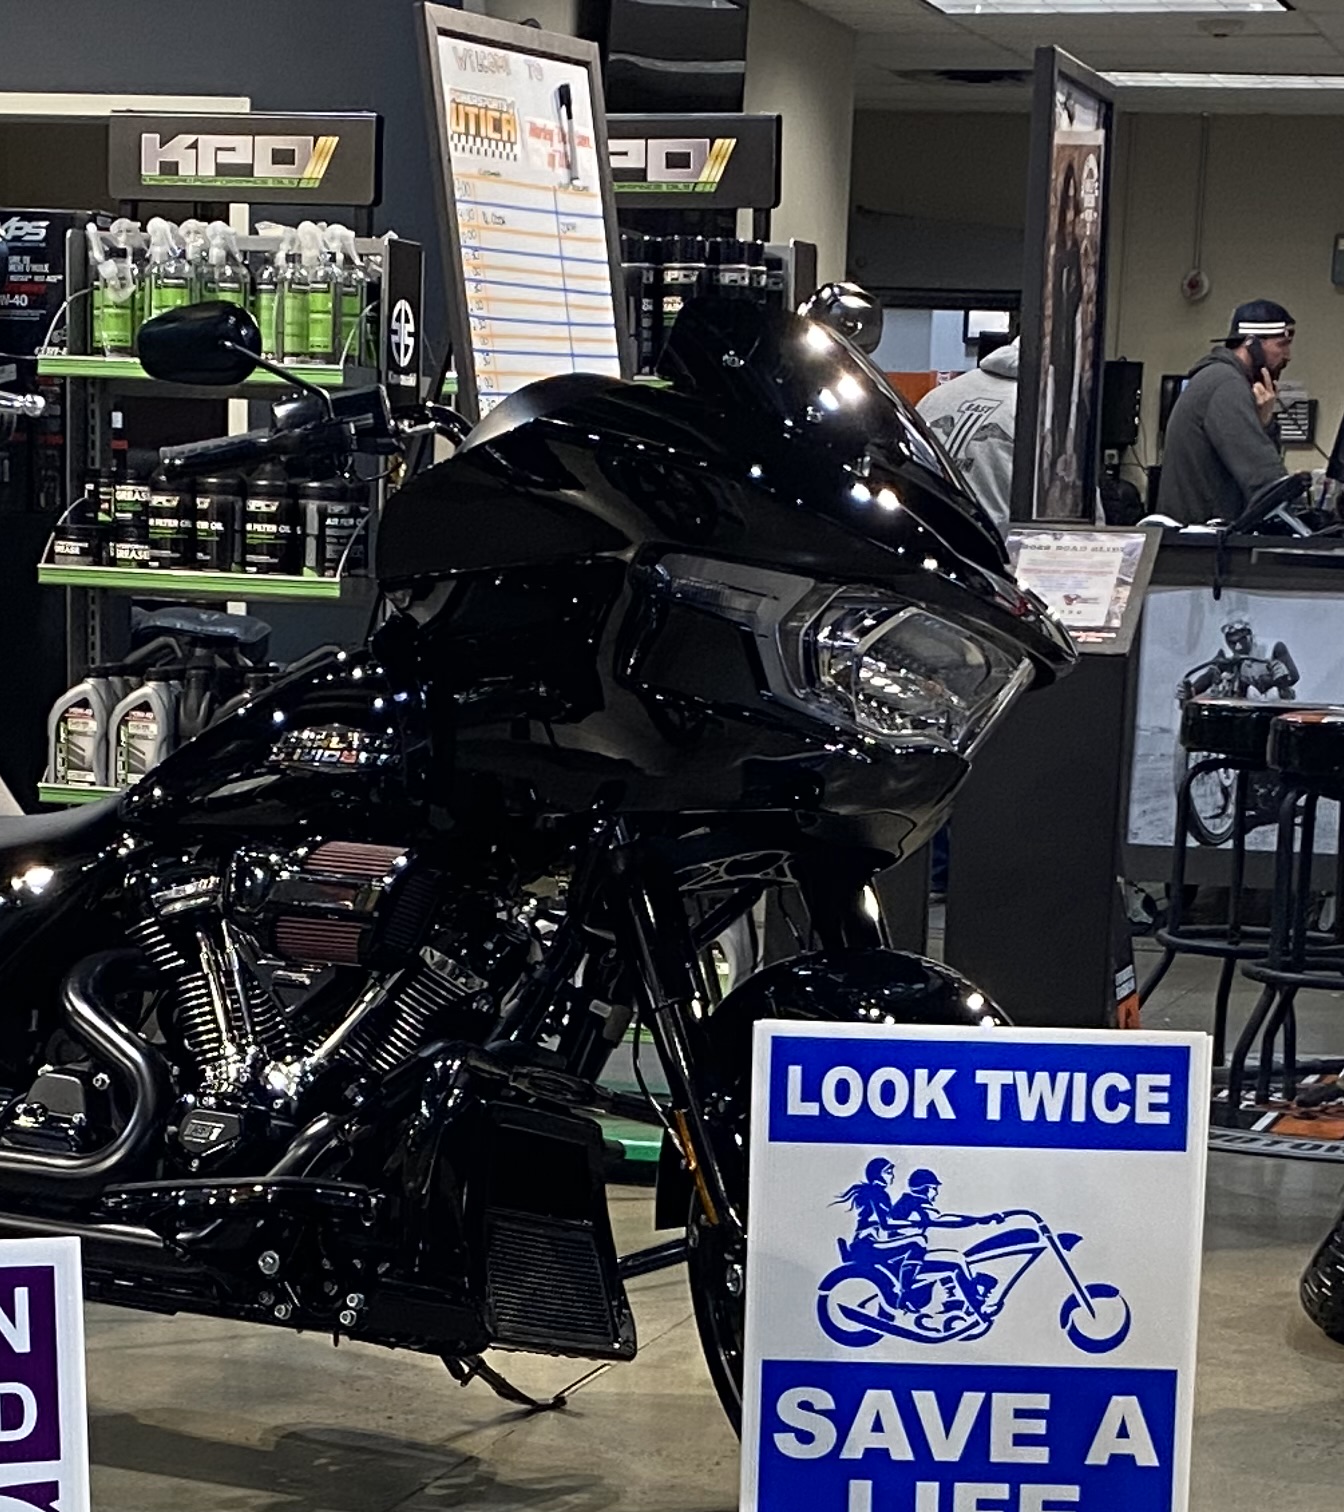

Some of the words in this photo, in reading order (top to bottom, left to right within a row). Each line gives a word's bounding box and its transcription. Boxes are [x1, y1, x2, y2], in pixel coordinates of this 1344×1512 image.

[451, 101, 517, 144] UTICA
[608, 138, 709, 182] PO
[786, 1064, 957, 1120] LOOK
[975, 1069, 1171, 1125] TWICE
[773, 1386, 1050, 1464] SAVE
[1084, 1395, 1160, 1467] A
